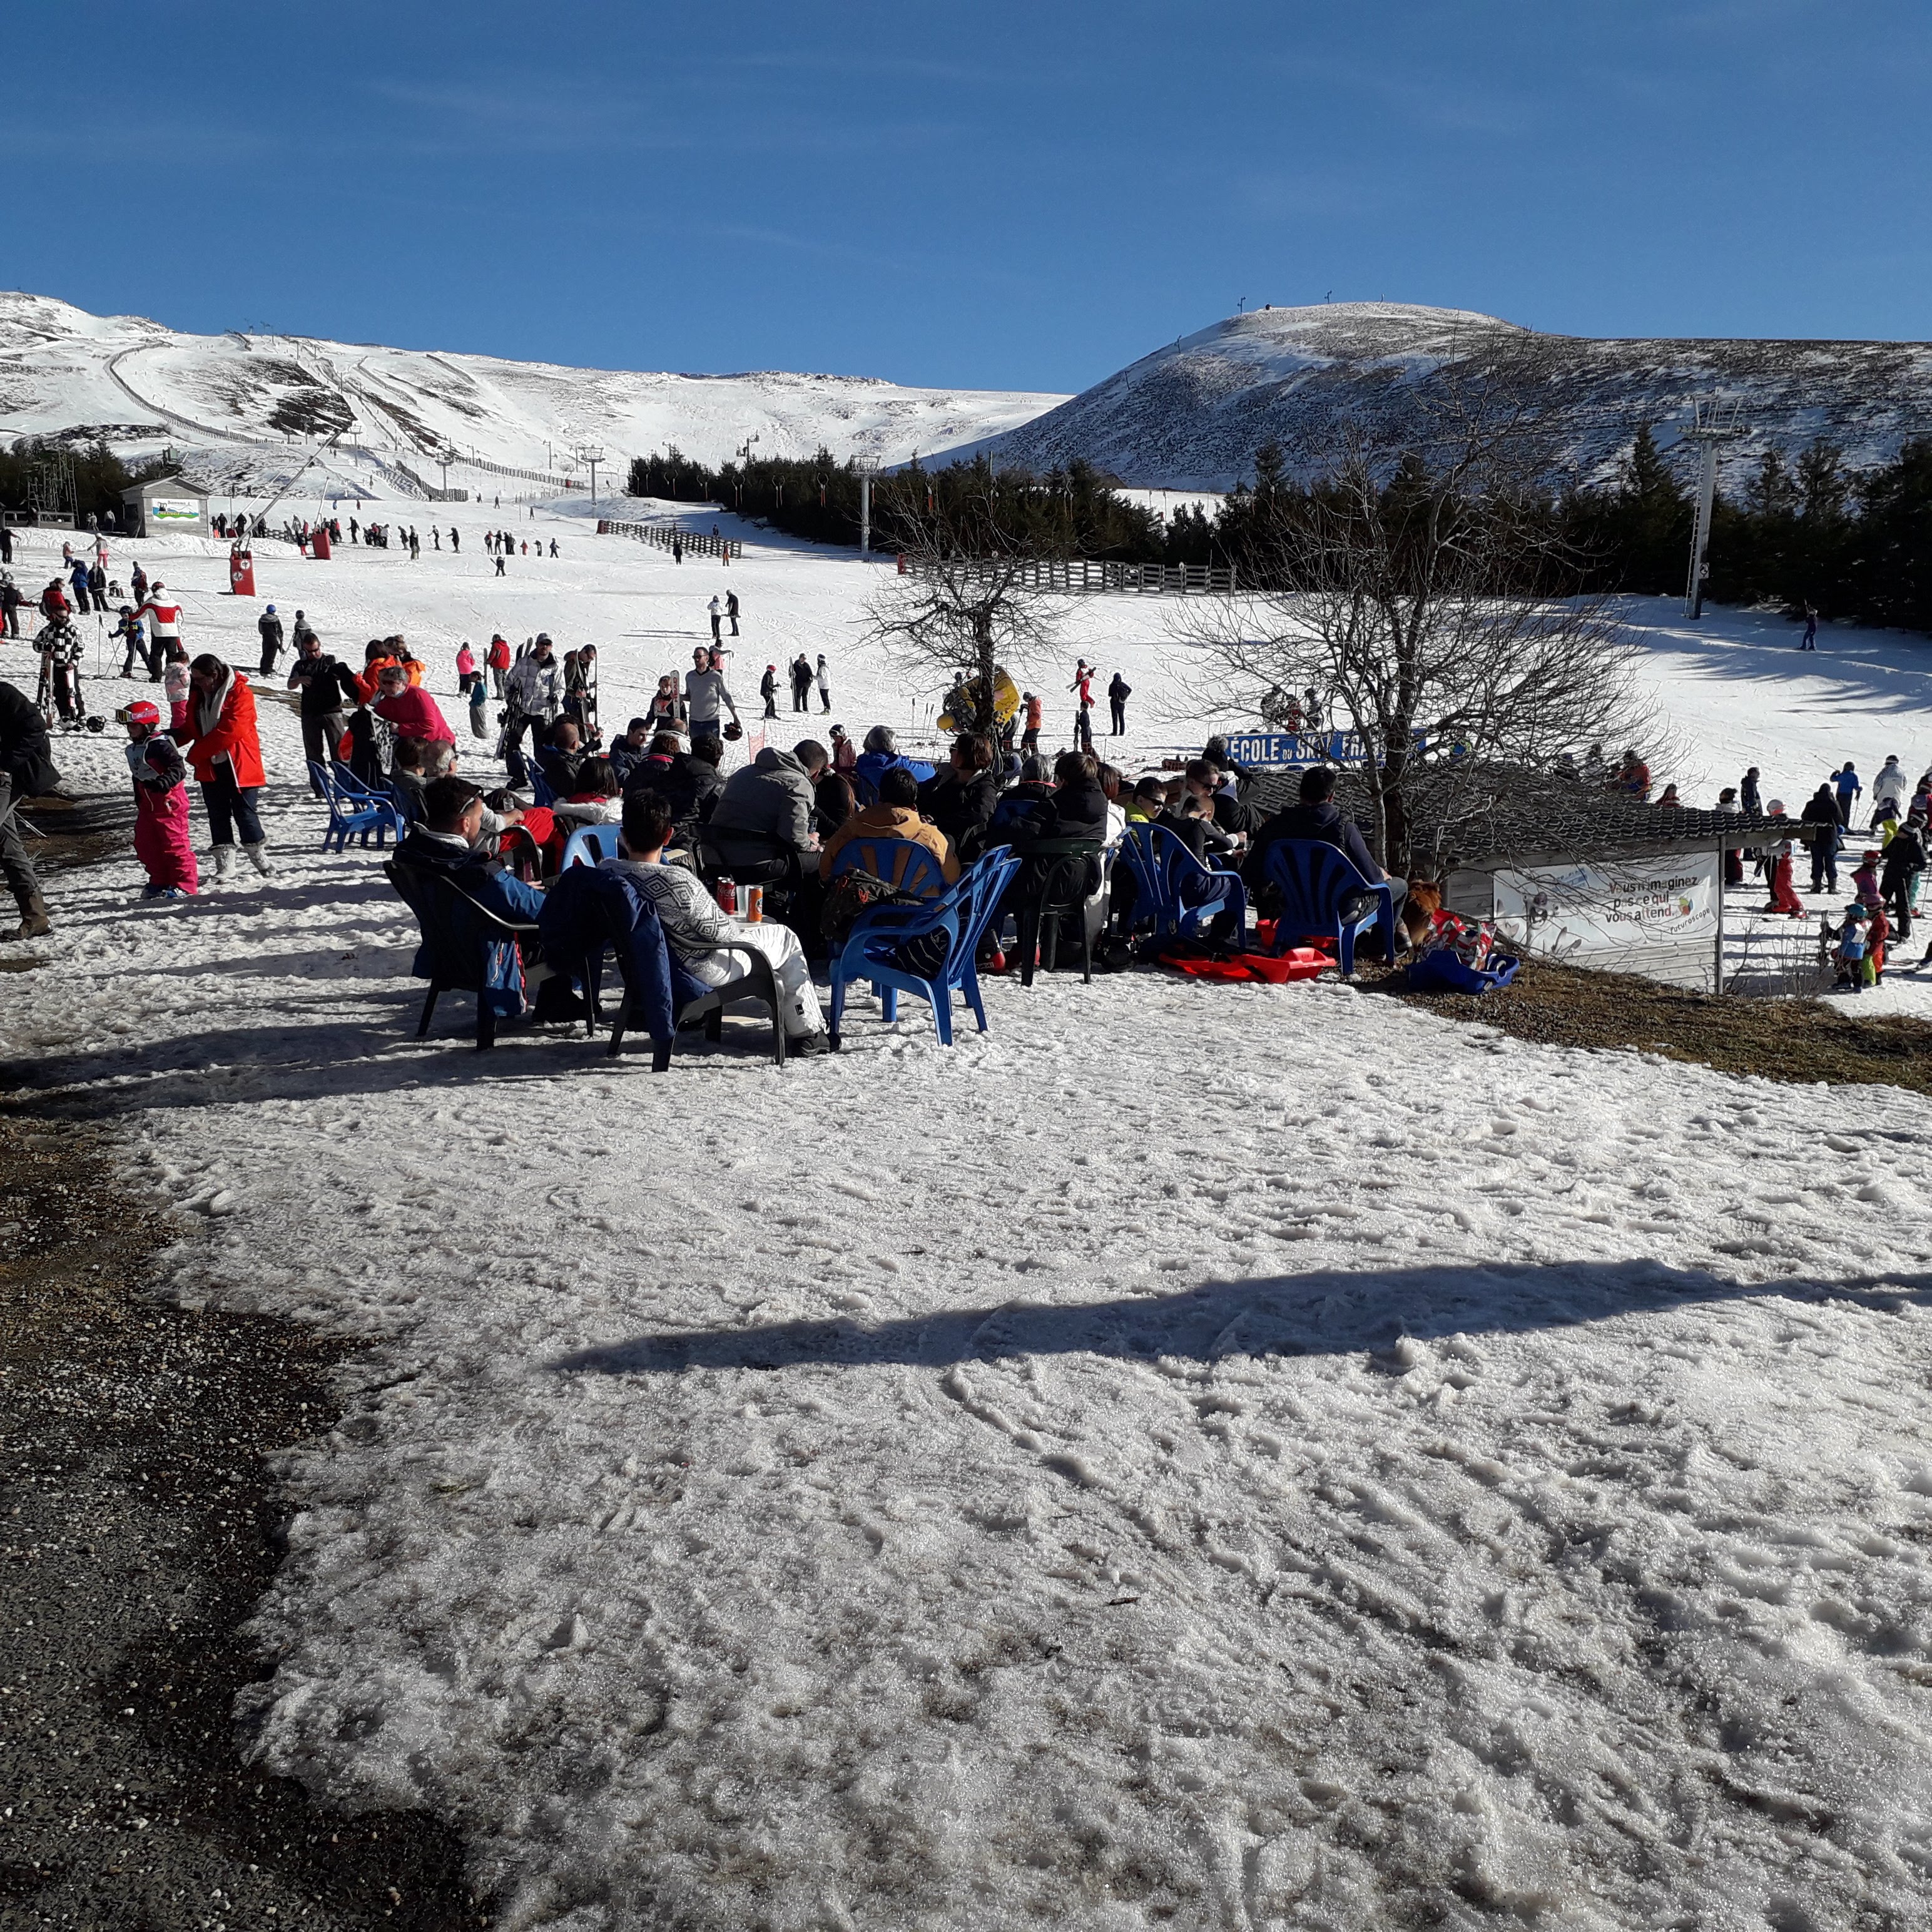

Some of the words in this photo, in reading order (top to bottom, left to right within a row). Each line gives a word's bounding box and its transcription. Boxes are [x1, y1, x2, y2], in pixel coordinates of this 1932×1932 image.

[1231, 737, 1279, 763] ÉCOLE
[1283, 749, 1293, 761] DU
[1609, 882, 1636, 894] Vous
[1614, 897, 1634, 910] pas
[1652, 890, 1669, 906] qui
[1605, 911, 1632, 923] vous
